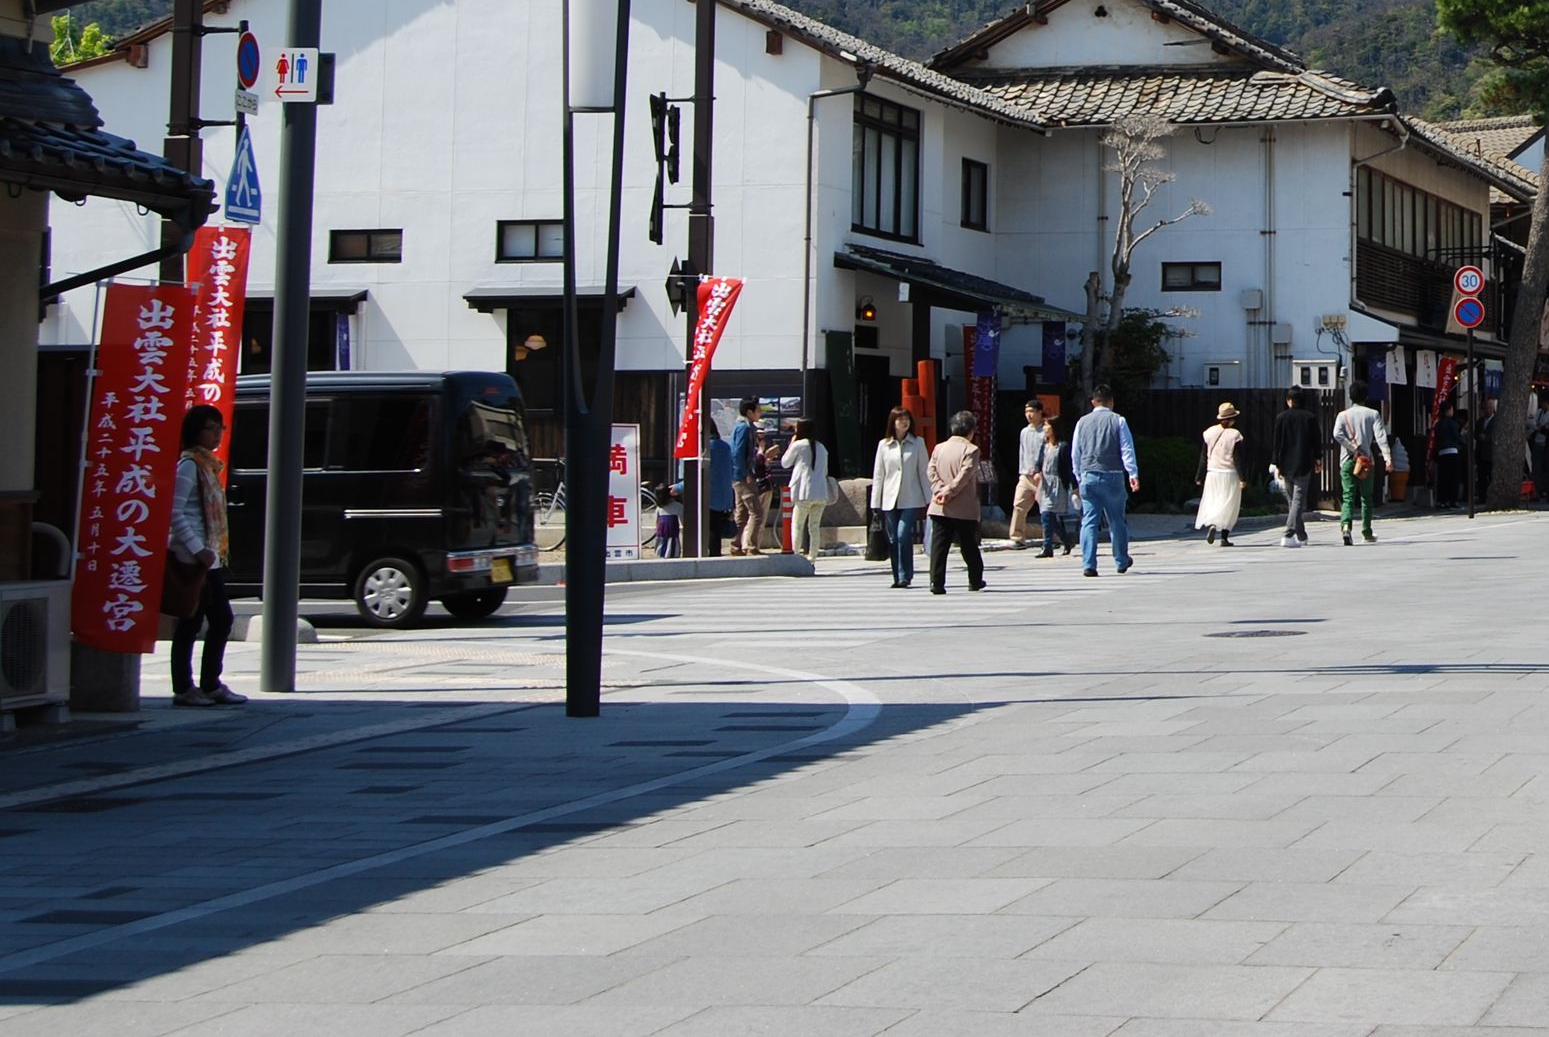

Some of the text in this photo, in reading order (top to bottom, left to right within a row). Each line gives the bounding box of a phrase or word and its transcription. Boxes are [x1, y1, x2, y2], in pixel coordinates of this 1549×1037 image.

[198, 236, 238, 405] 出雲大社平成の
[1462, 274, 1478, 288] 30
[102, 298, 176, 632] 出雲大社平成の大遷宮
[87, 505, 105, 572] 五月十日
